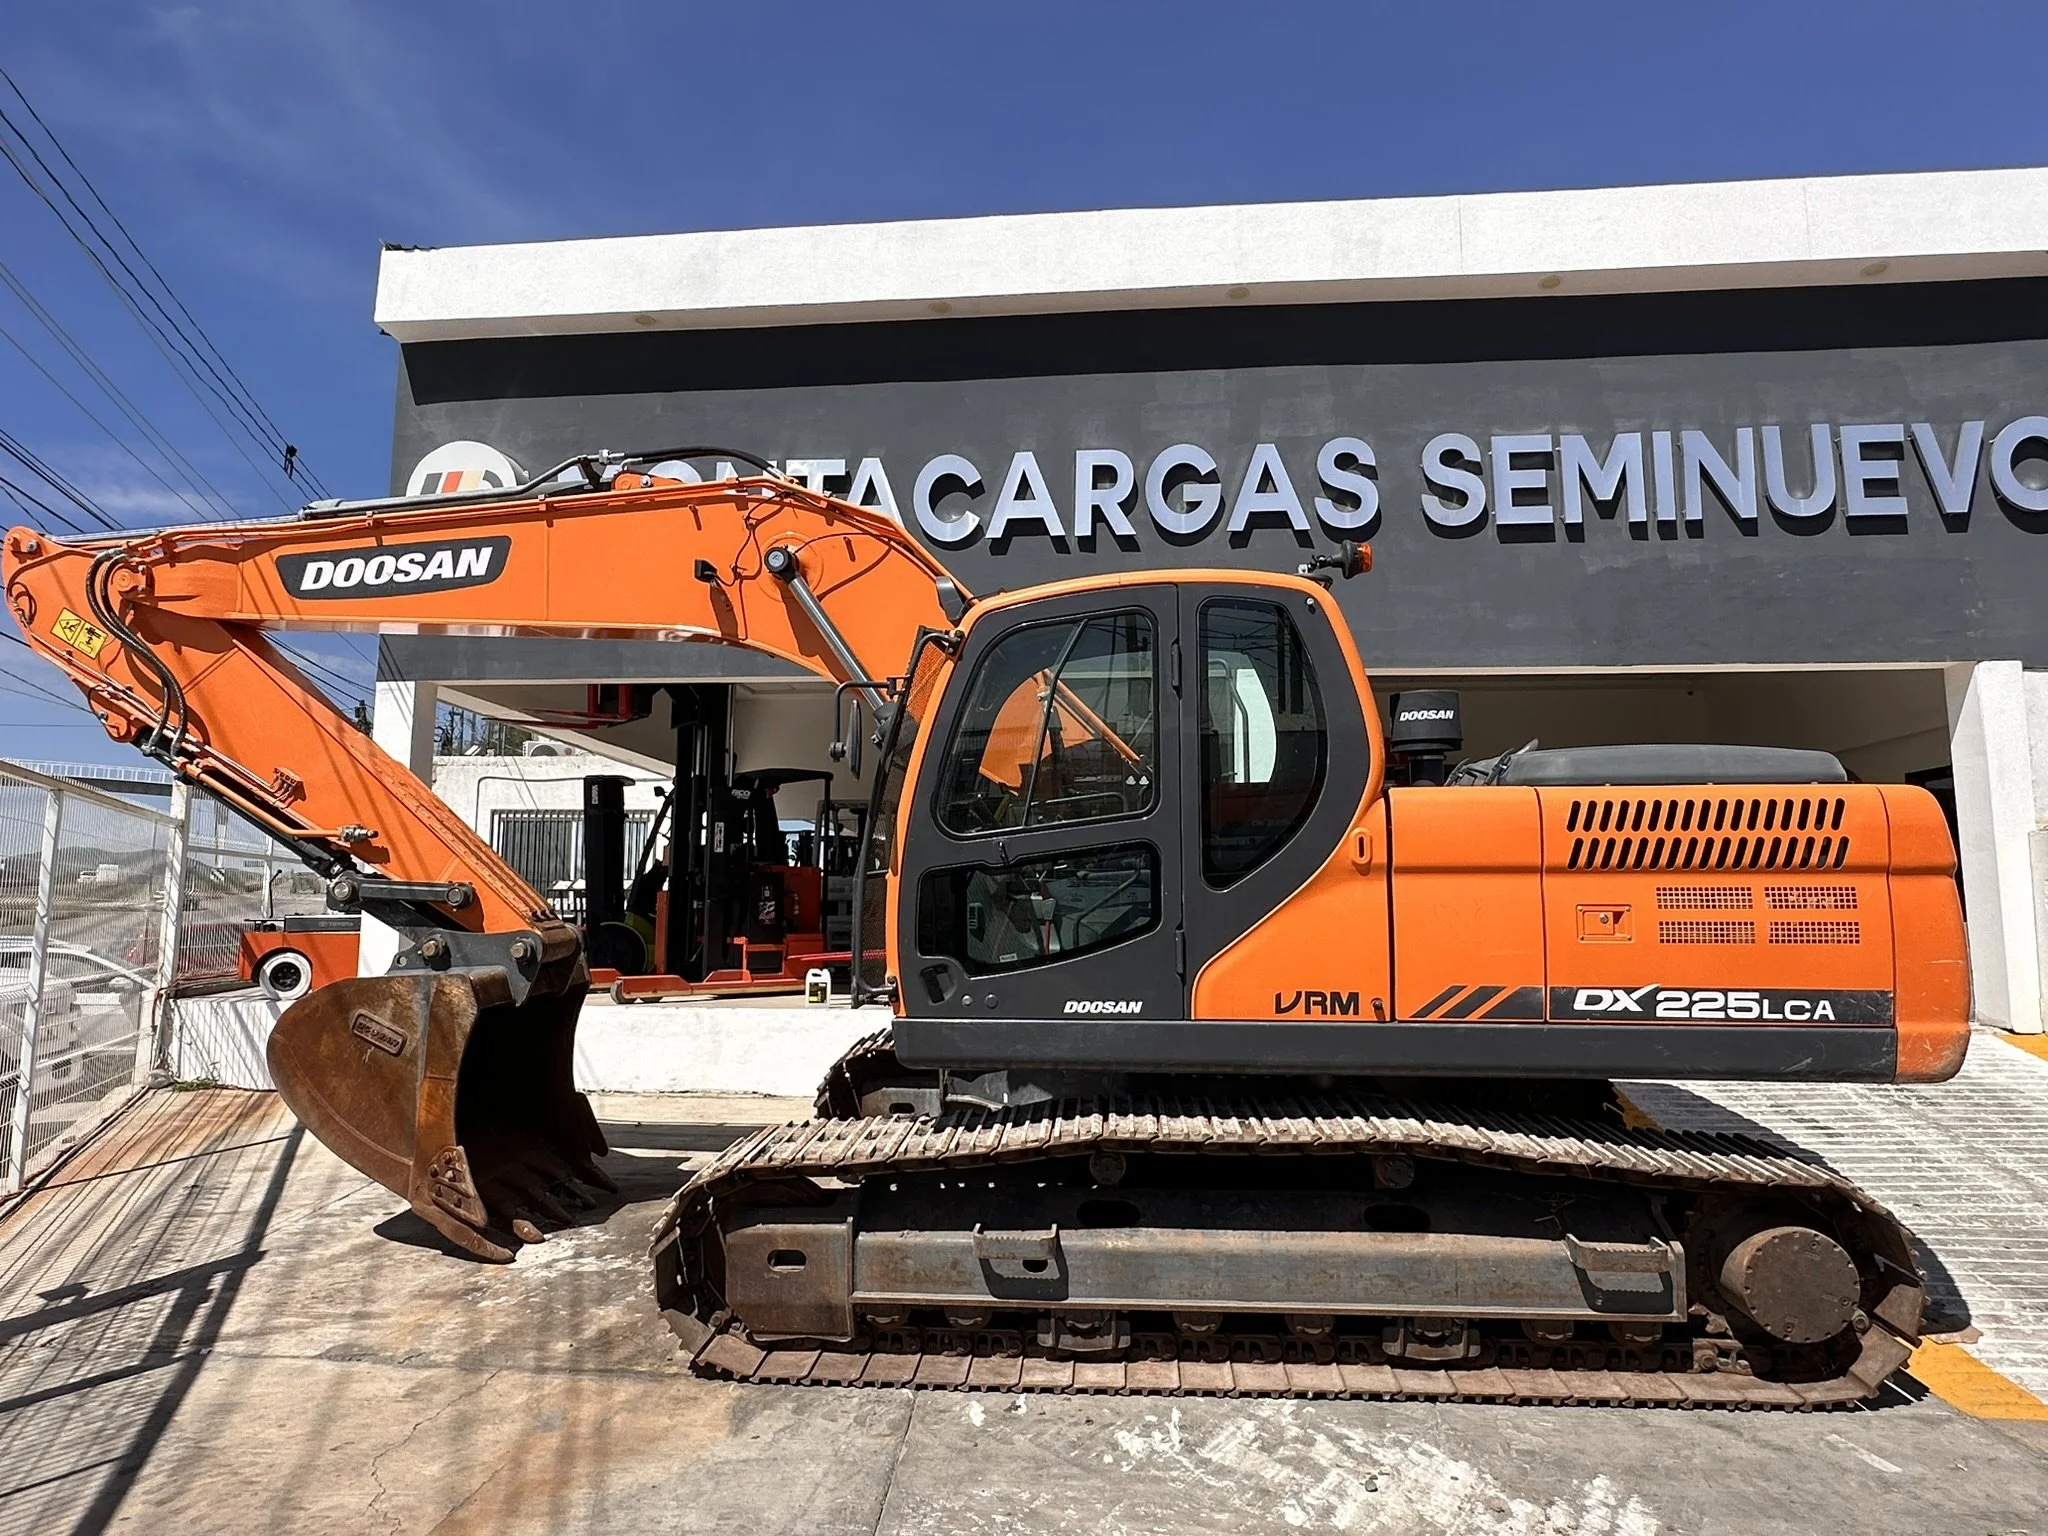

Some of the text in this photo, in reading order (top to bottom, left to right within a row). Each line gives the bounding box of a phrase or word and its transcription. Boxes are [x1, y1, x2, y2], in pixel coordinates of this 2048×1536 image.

[557, 416, 2048, 542] TACARGAS SEMINUEVO
[299, 546, 493, 591] DOOSAN
[1399, 709, 1455, 722] DOOSAN
[1063, 999, 1143, 1014] DOOSAN
[1573, 984, 1660, 1013] DX
